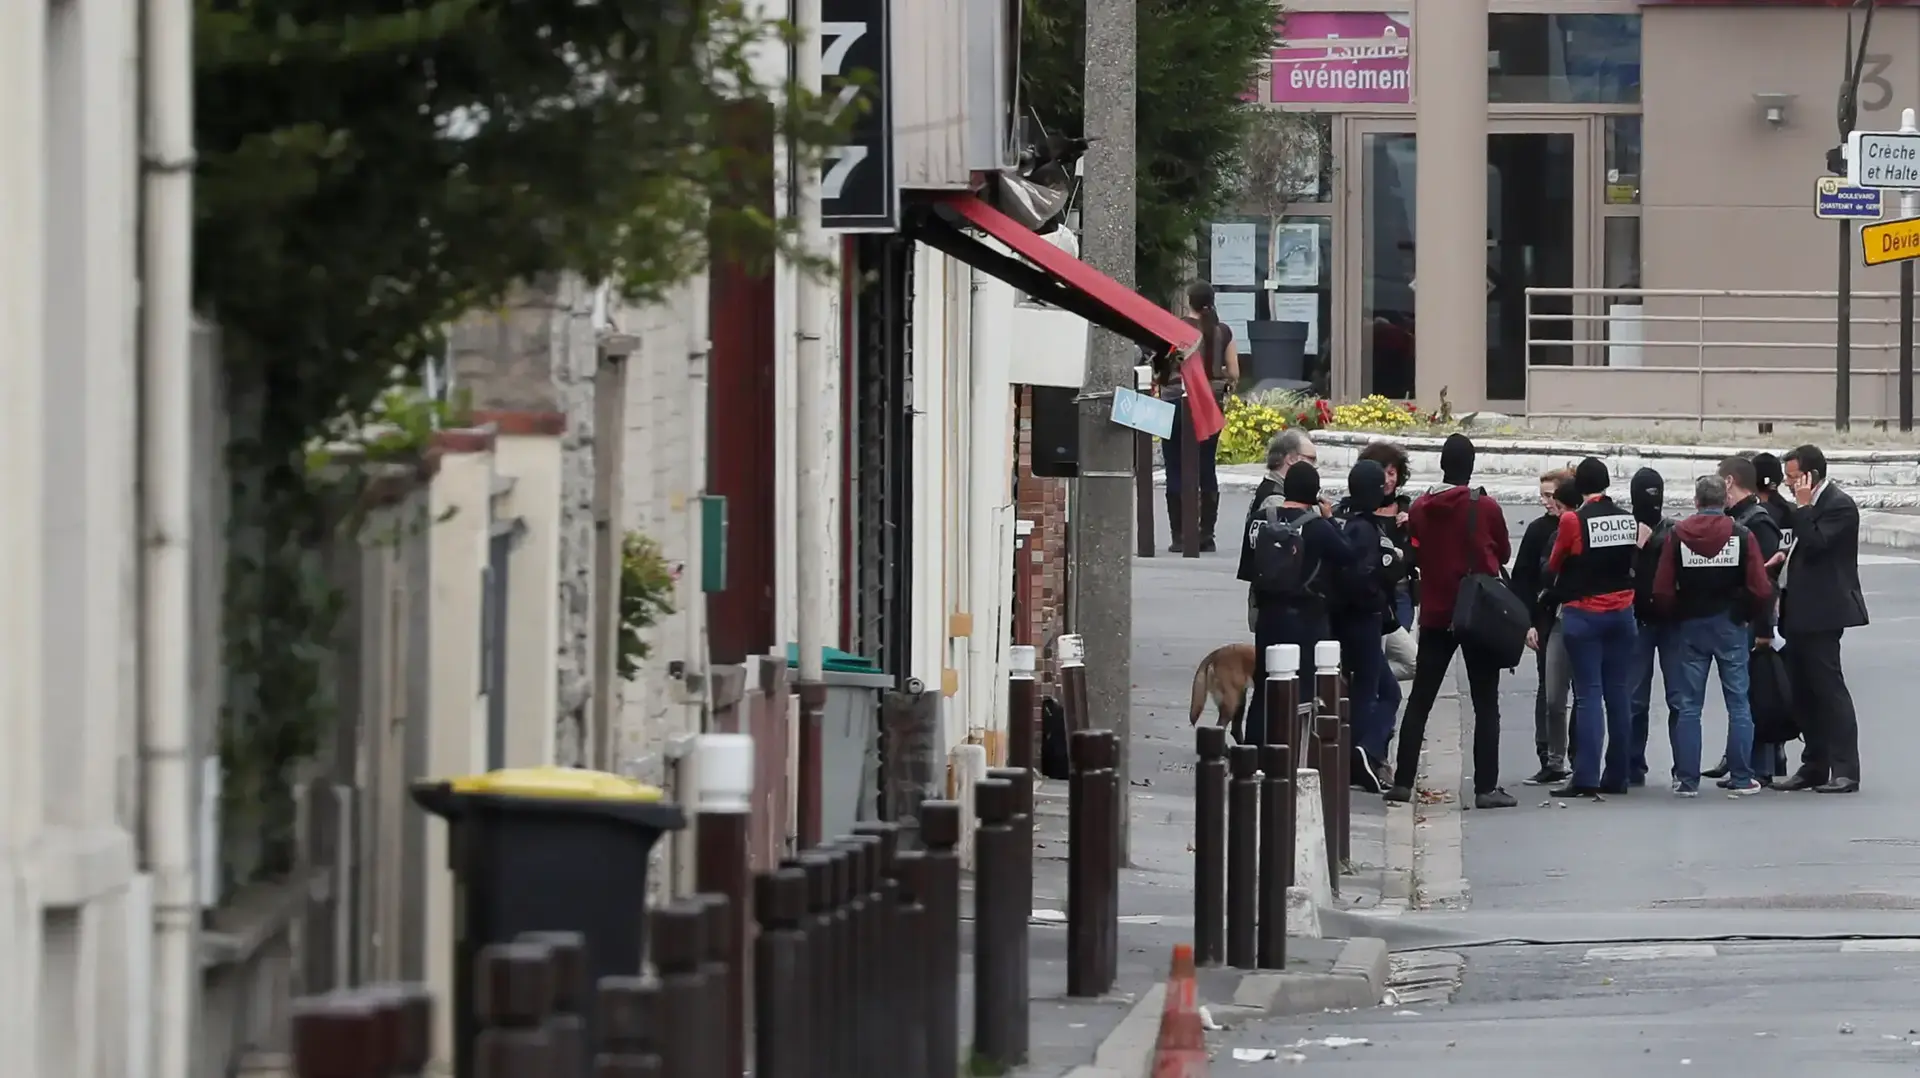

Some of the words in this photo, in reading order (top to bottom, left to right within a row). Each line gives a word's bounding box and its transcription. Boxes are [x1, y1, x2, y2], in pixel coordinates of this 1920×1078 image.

[1862, 54, 1893, 112] 3
[1869, 143, 1916, 160] Crèche
[1868, 166, 1881, 178] et
[1885, 165, 1919, 181] Halte
[1838, 192, 1876, 200] BOULEVARD
[1883, 229, 1920, 252] Dévia
[1590, 519, 1636, 533] POLICE
[1592, 533, 1636, 543] JUDICIAIRE
[1688, 557, 1735, 565] JUDICIAIRE
